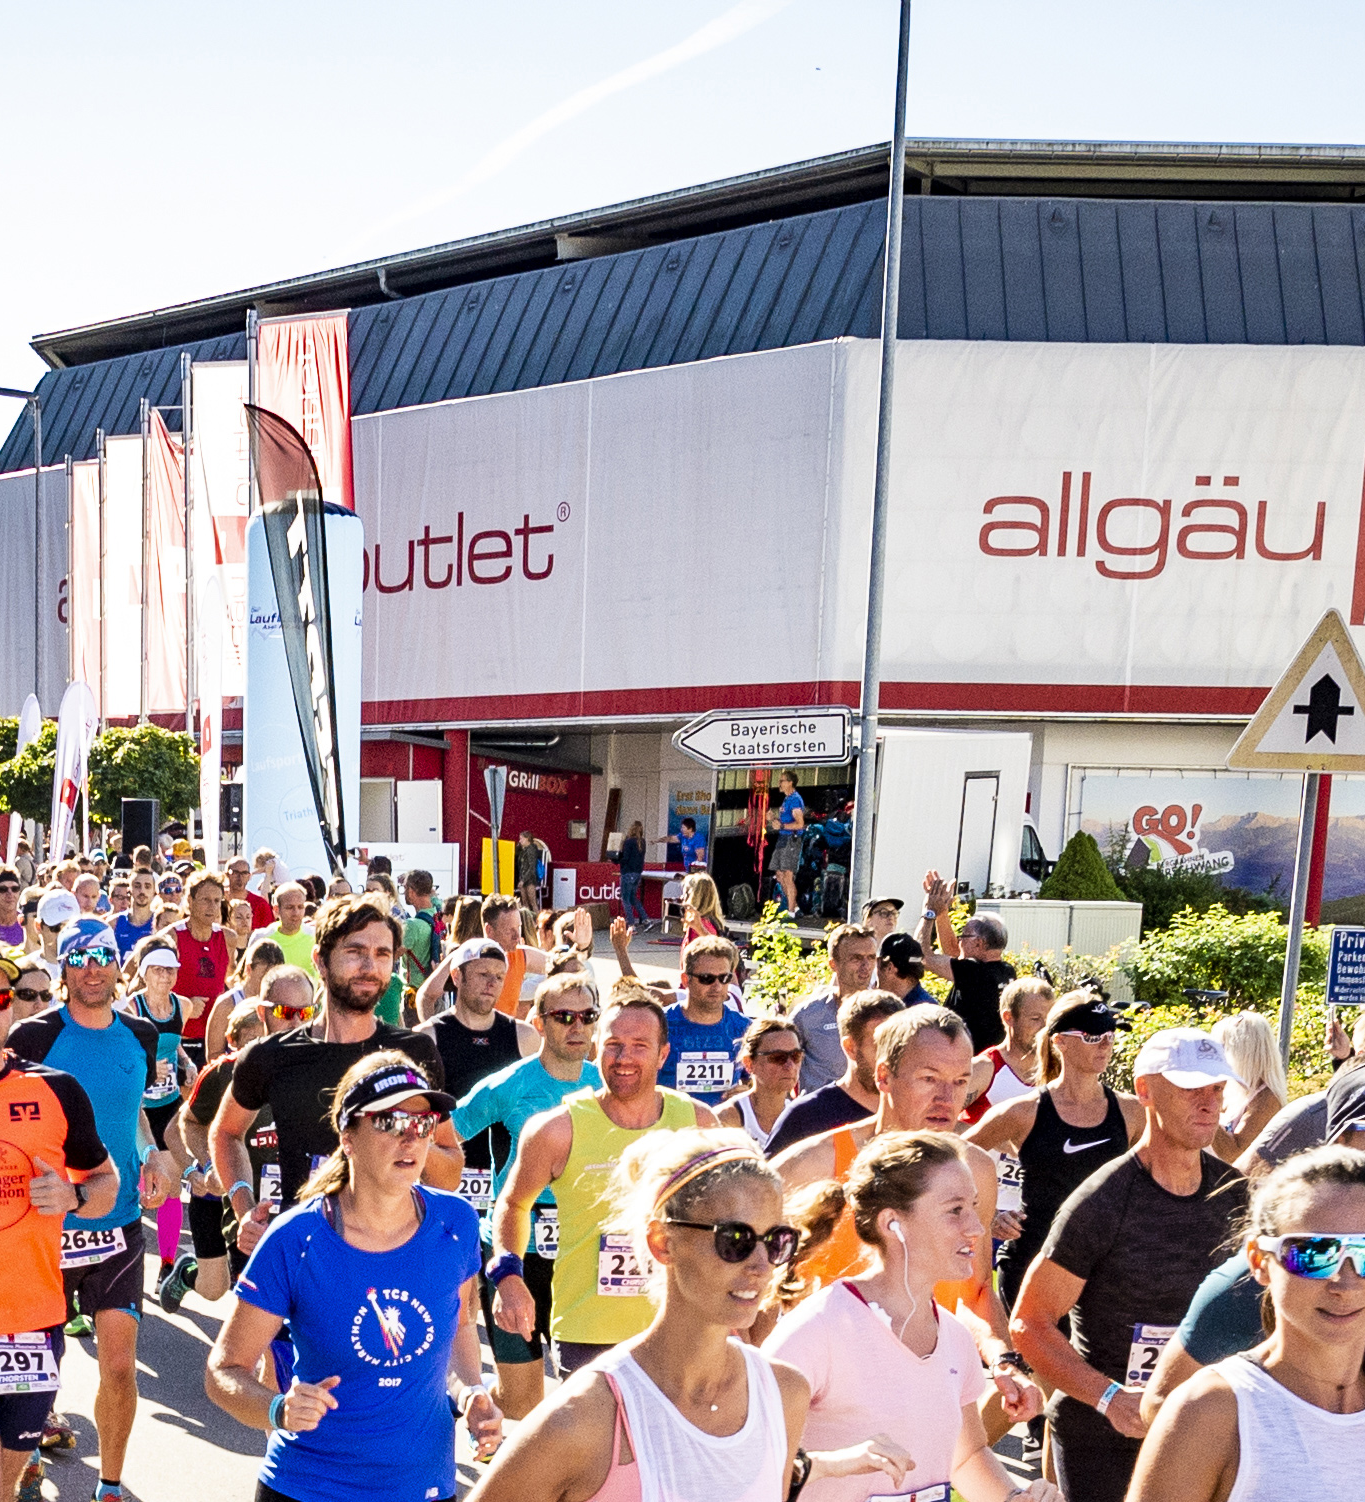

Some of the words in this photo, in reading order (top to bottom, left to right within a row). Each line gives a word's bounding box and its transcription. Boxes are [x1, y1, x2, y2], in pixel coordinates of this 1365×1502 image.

[979, 471, 1327, 580] allgäu
[363, 511, 554, 594] utlet
[730, 721, 817, 740] Bayerische
[722, 740, 826, 756] Staatsforsten
[1133, 803, 1203, 840] GO!
[686, 1064, 724, 1079] 2211
[459, 1179, 492, 1195] 207
[61, 1230, 116, 1251] 2648
[382, 1288, 409, 1302] TCS
[411, 1298, 433, 1323] NEW
[350, 1305, 381, 1366] MARATHON
[415, 1325, 435, 1356] YORK
[383, 1354, 412, 1367] CITY
[378, 1377, 403, 1387] 2017
